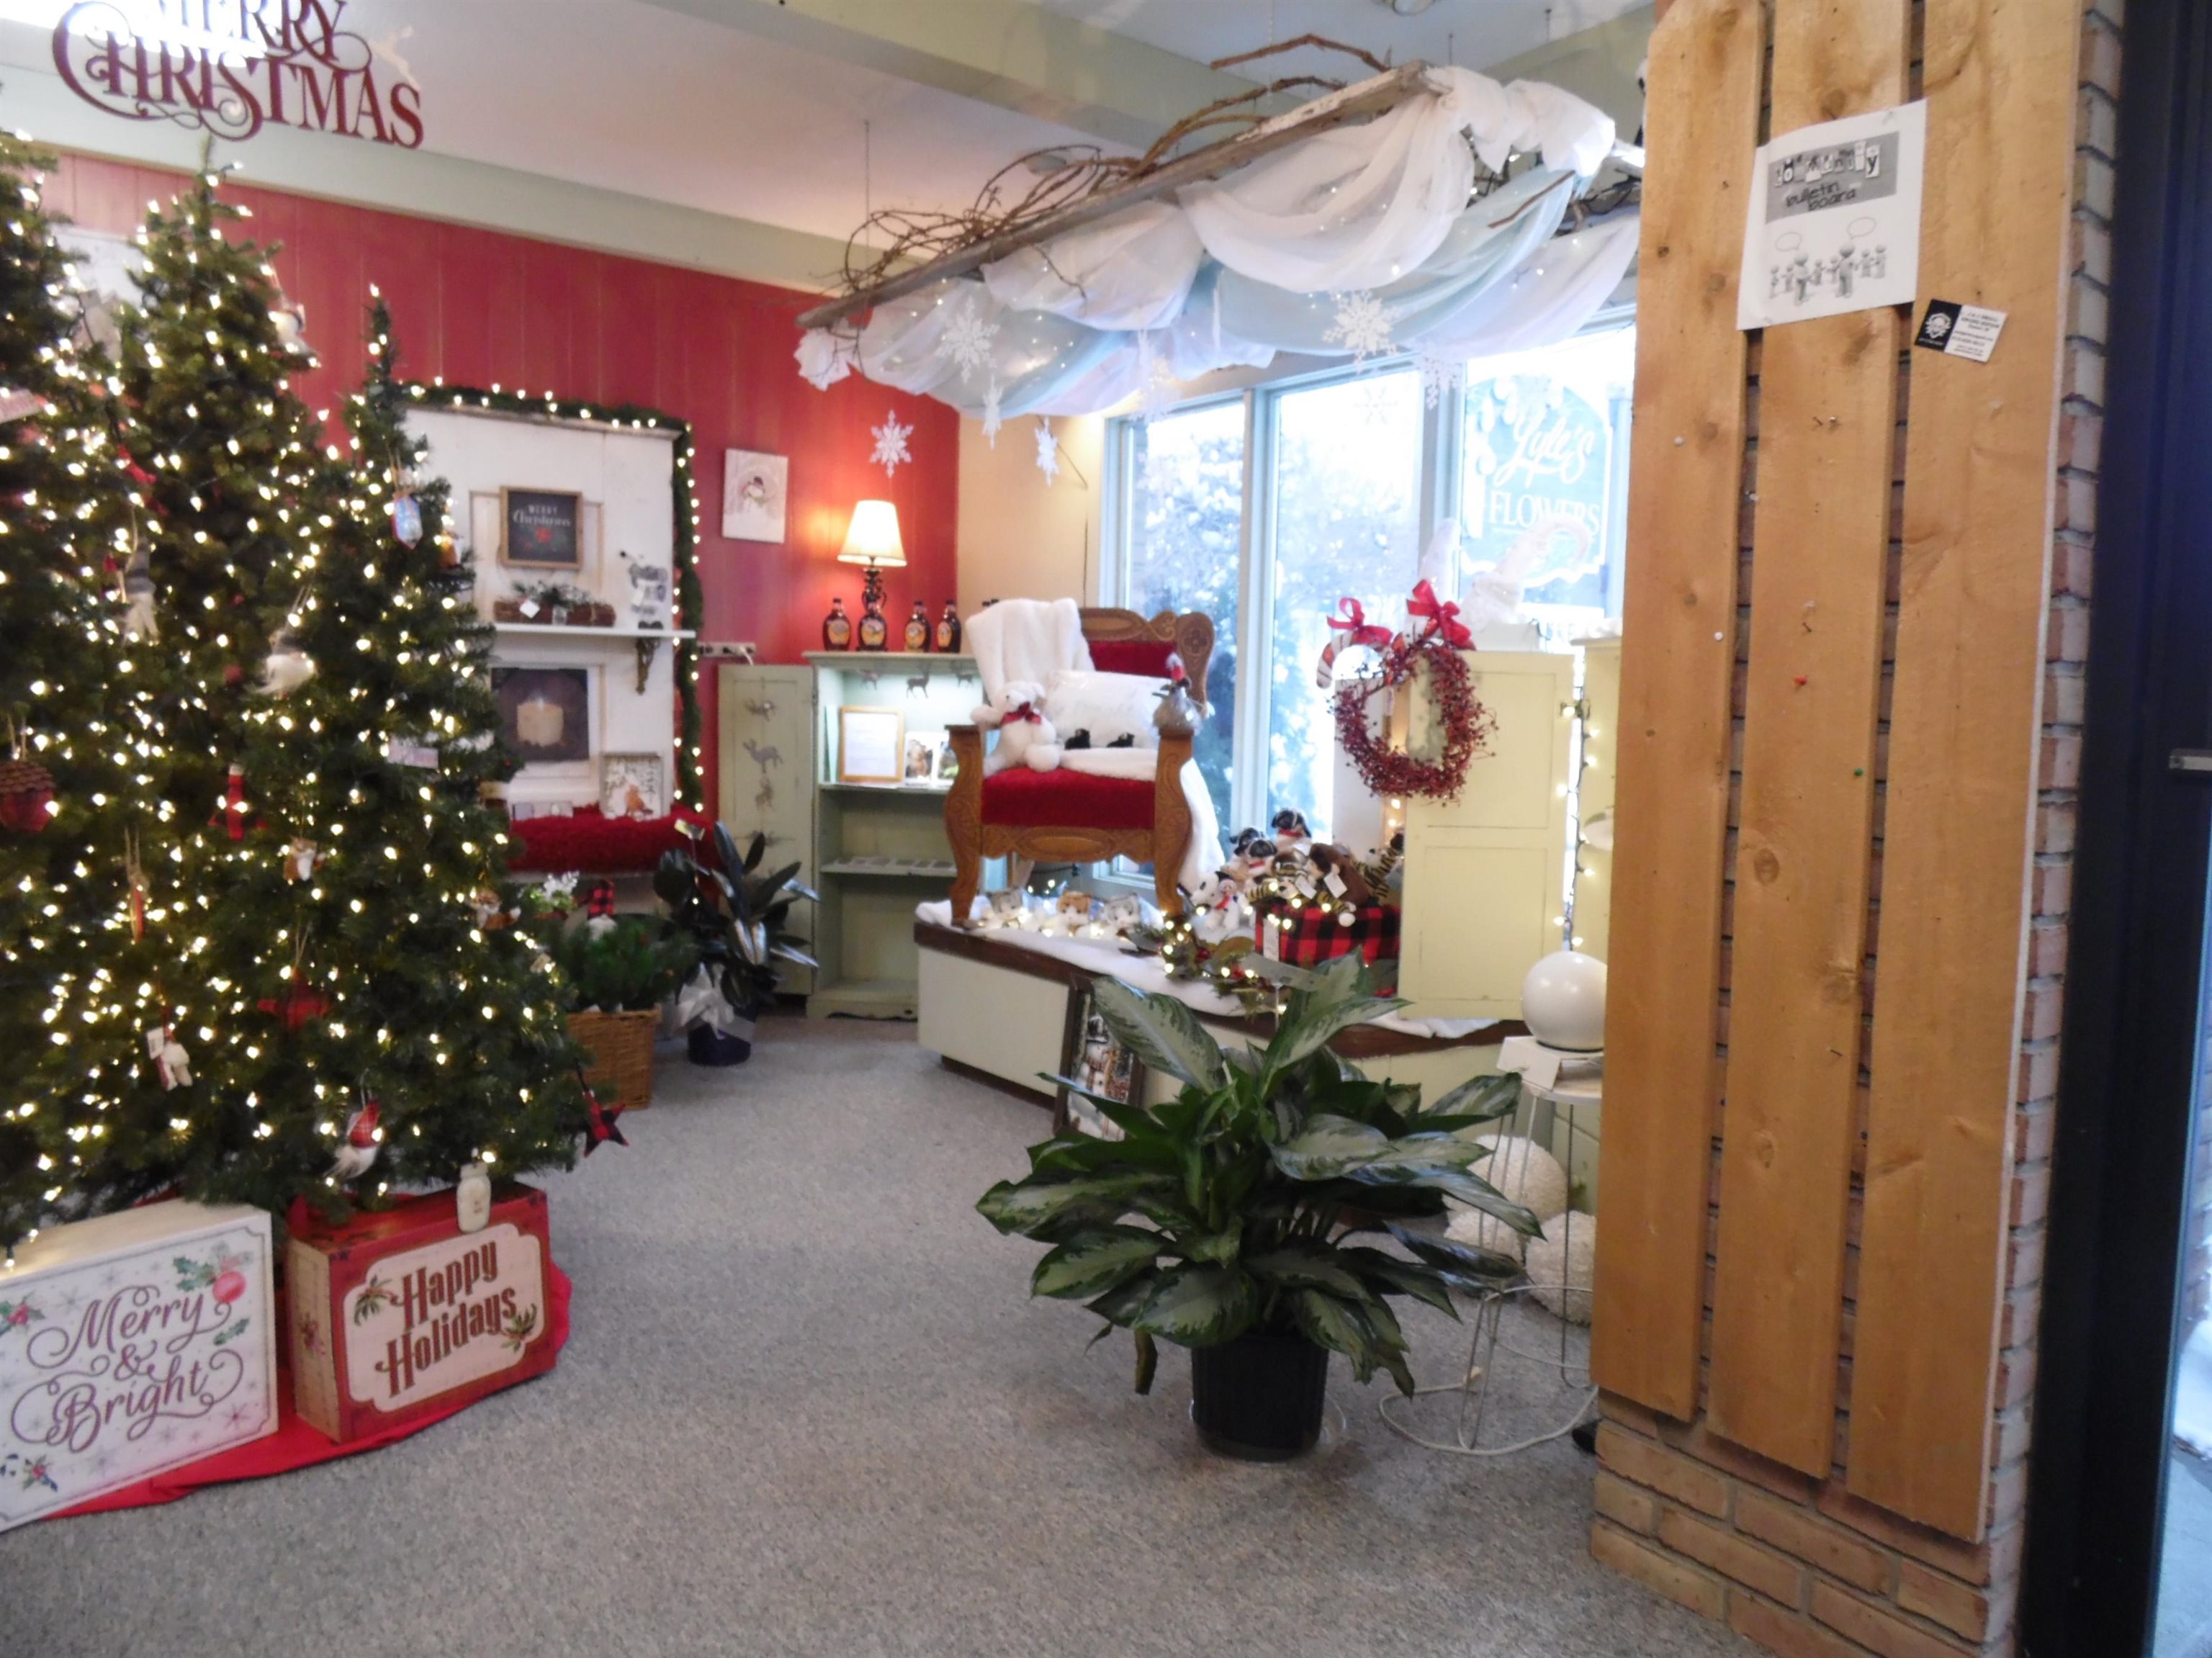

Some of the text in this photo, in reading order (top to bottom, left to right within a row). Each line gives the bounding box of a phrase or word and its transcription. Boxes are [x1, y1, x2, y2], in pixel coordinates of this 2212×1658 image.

[53, 1, 424, 149] CHRISTMAS
[1809, 188, 1856, 212] board
[27, 1285, 231, 1369] Merry
[390, 1240, 498, 1332] Happy
[114, 1340, 158, 1382] &
[374, 1287, 517, 1398] Holidays
[10, 1348, 243, 1454] Bright
